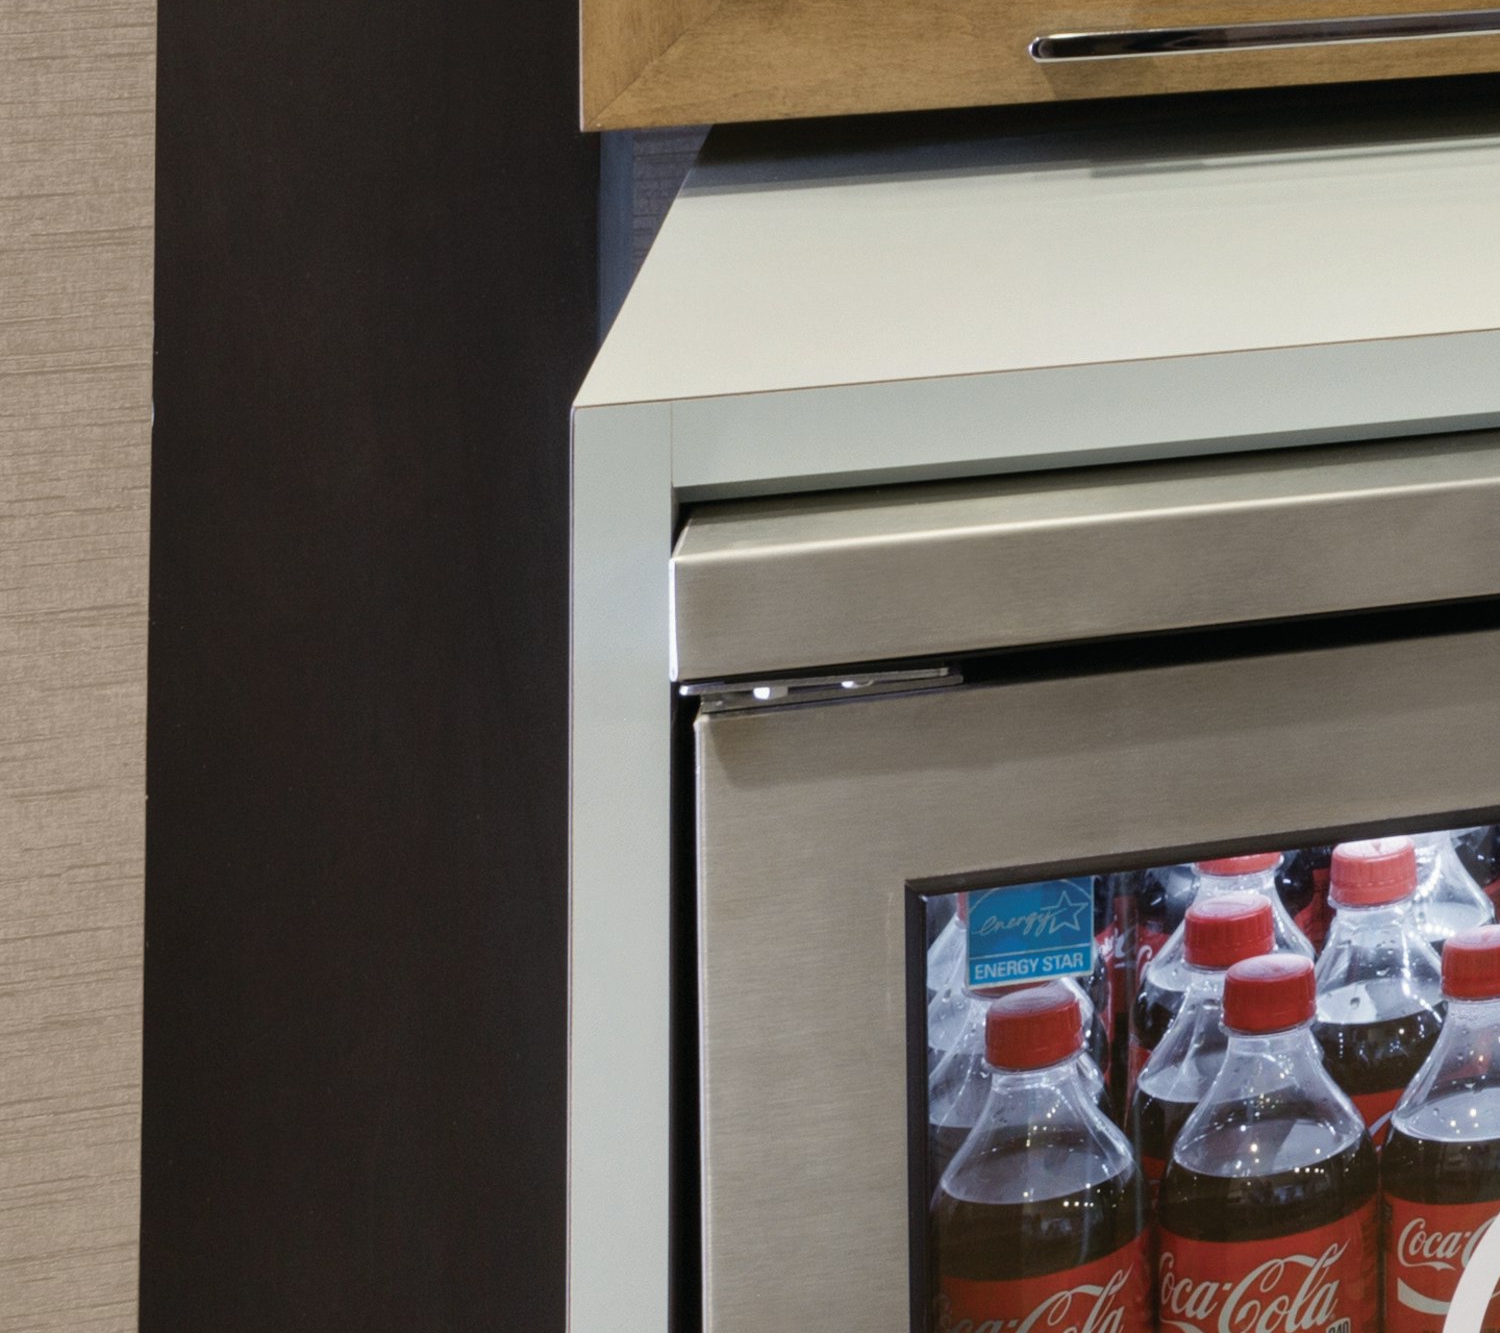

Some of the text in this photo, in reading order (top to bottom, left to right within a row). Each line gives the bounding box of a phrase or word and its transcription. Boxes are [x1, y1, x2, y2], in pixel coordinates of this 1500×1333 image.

[974, 951, 1084, 981] ENERGY STAR
[1159, 1238, 1352, 1333] Coca-Cola
